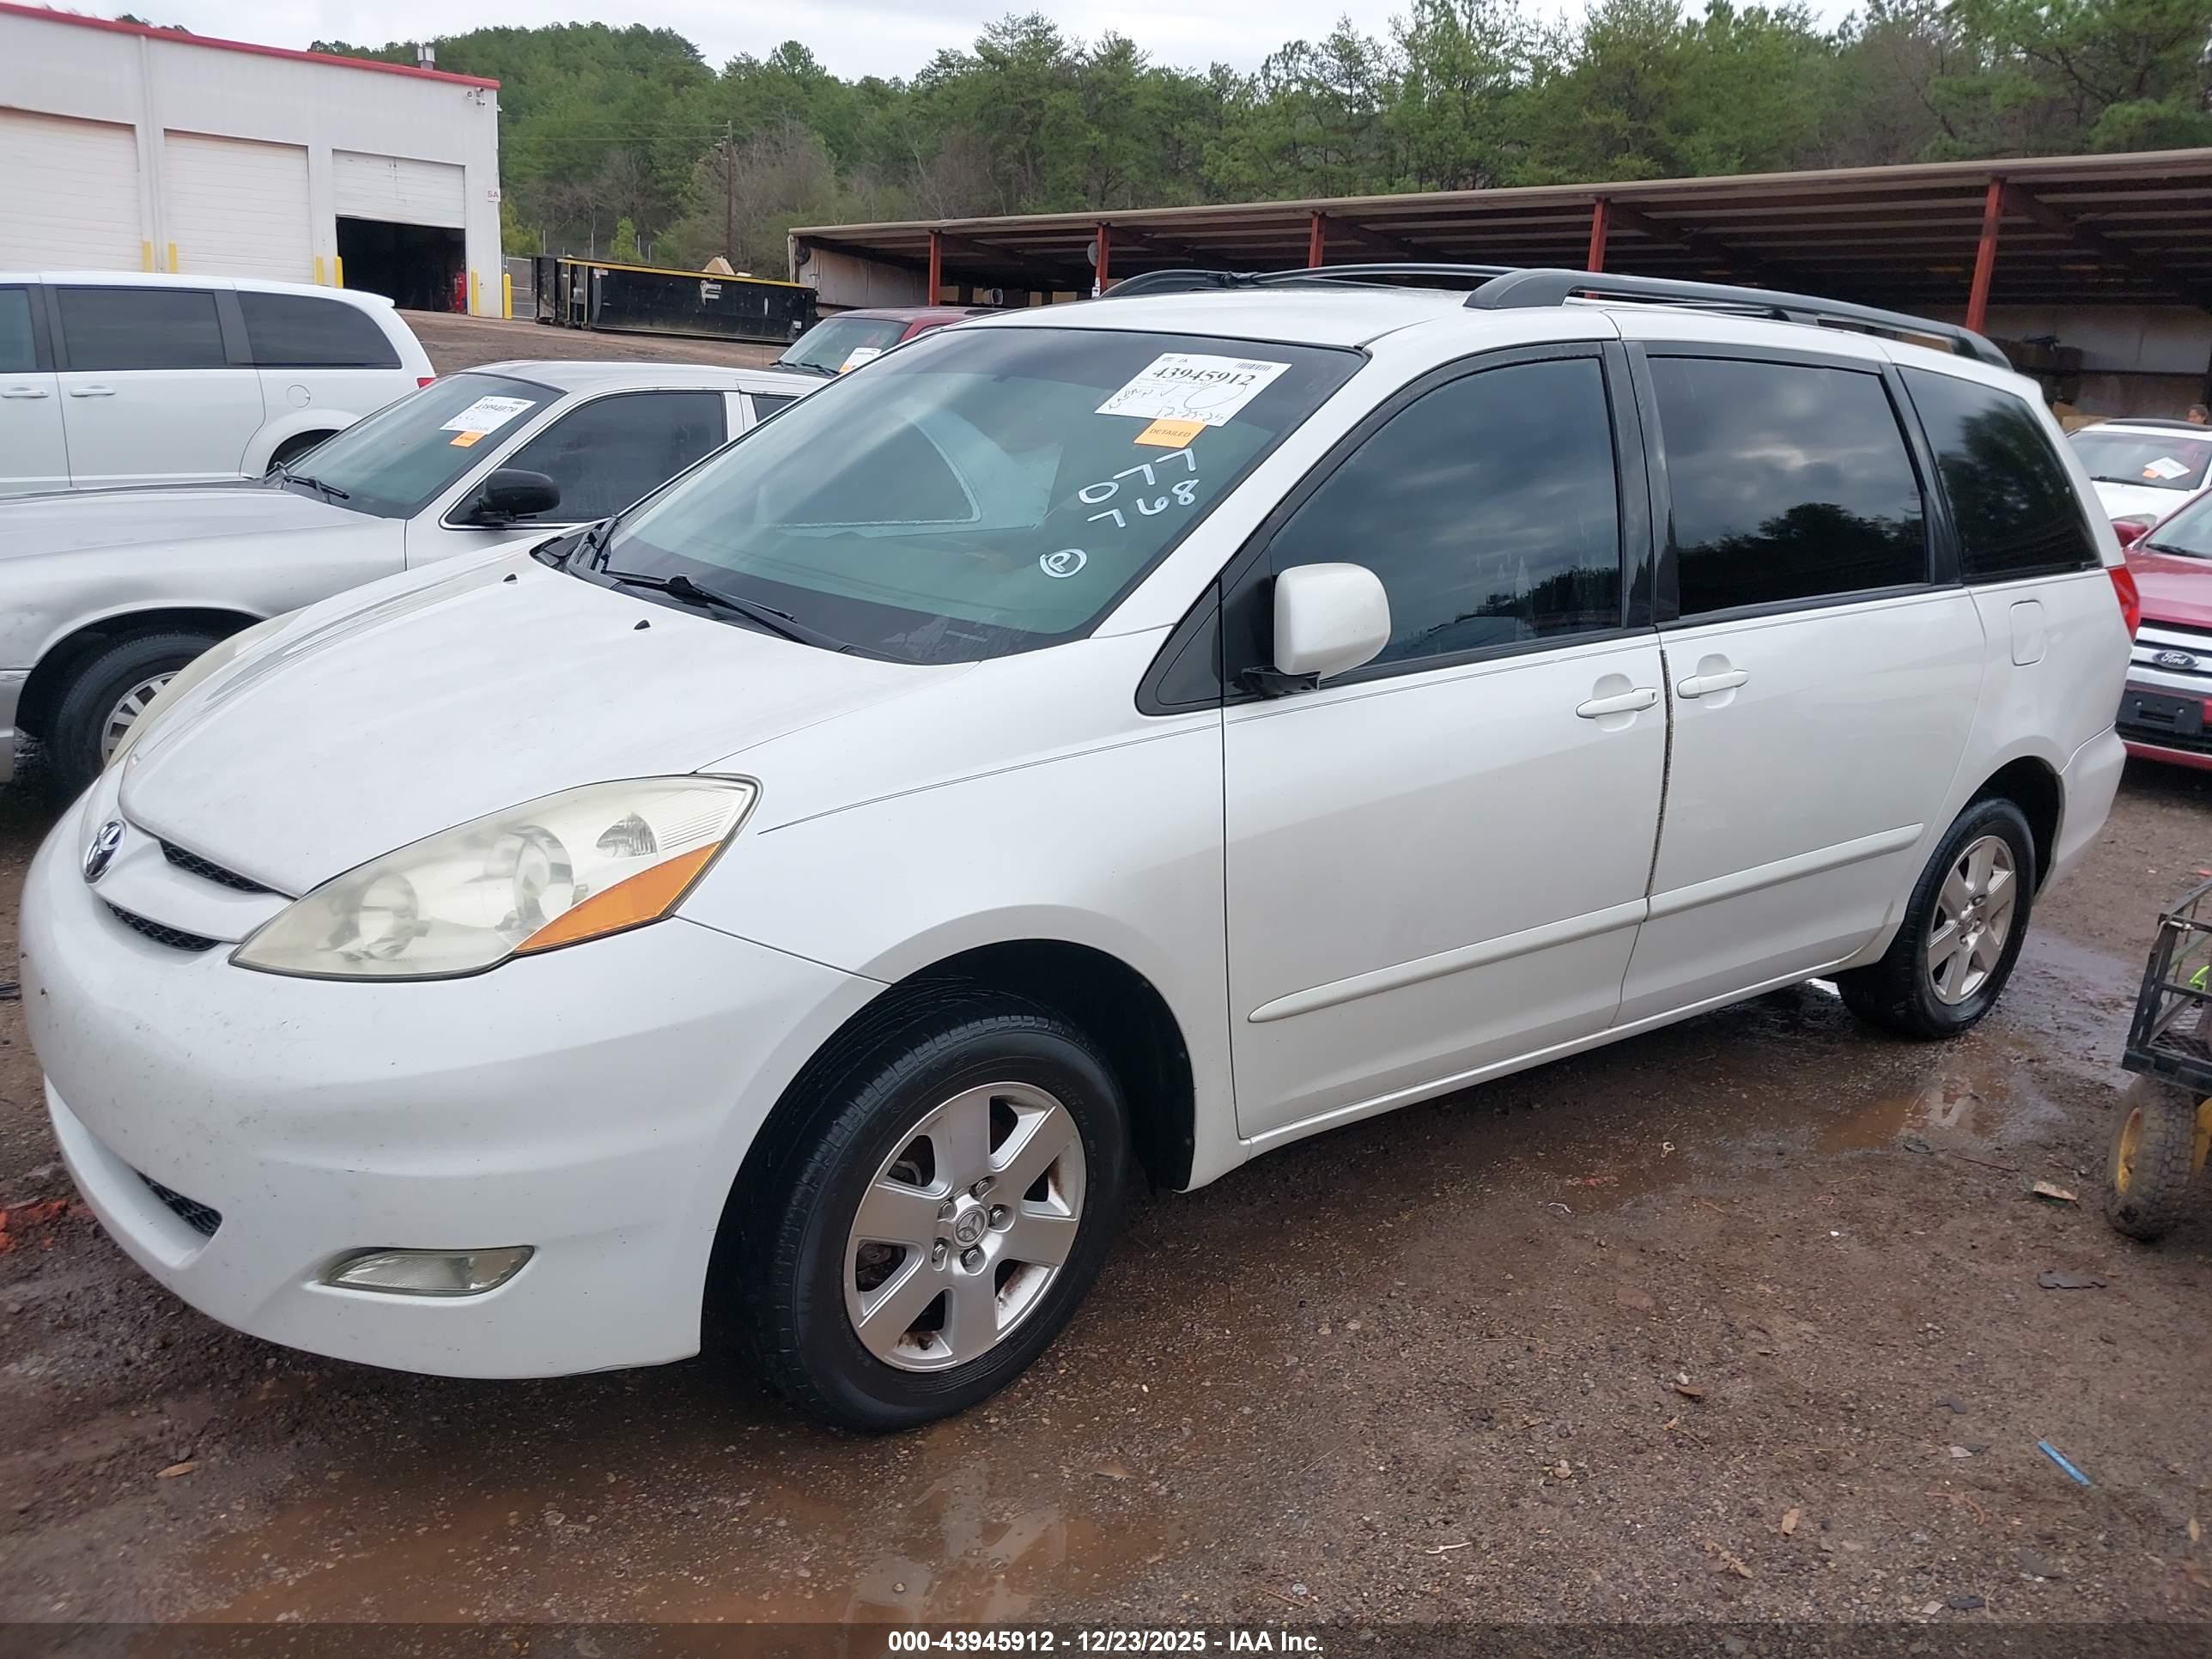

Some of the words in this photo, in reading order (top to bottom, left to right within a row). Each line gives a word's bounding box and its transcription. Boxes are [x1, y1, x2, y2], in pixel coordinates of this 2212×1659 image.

[1152, 367, 1256, 386] 43945912
[1149, 428, 1192, 438] DETAILED
[1086, 478, 1200, 528] 768
[2160, 652, 2189, 665] Ford
